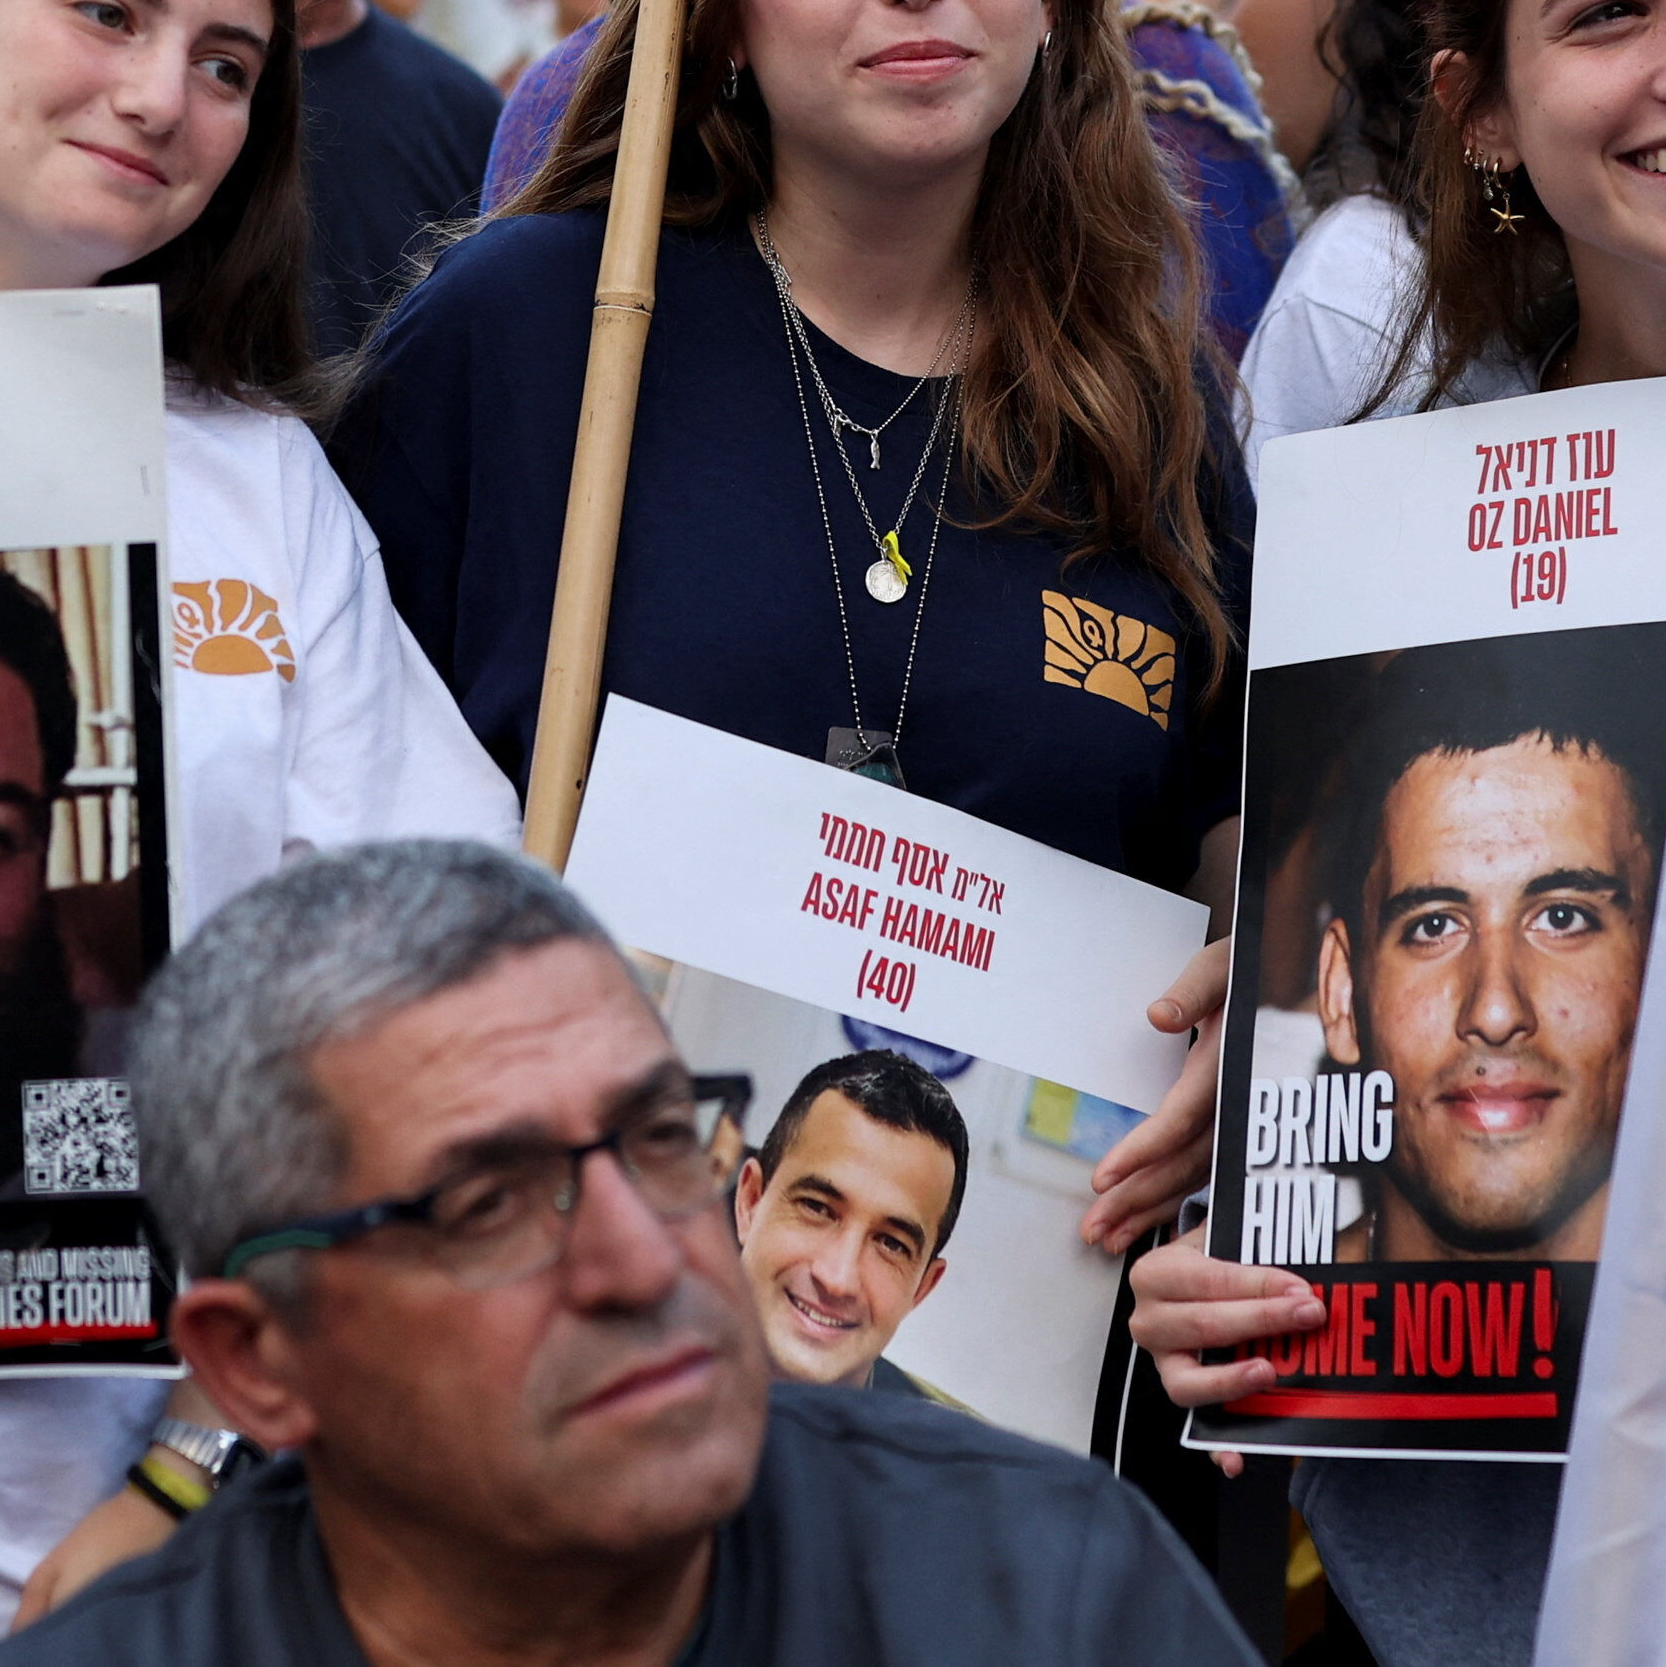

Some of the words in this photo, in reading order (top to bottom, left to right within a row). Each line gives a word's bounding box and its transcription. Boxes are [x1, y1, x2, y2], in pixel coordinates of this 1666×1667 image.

[1475, 436, 1558, 495] דניאל
[1566, 428, 1616, 483] עוז
[1467, 500, 1505, 552] OZ
[1513, 487, 1618, 547] DANIEL
[1510, 546, 1567, 610] (19)
[819, 812, 887, 874] חממי
[891, 836, 950, 895] אסף
[800, 871, 879, 931] ASAF
[879, 895, 996, 973] HAMAMI
[856, 949, 916, 1014] (40)
[1247, 1070, 1394, 1166] BRING
[1240, 1174, 1335, 1266] HIM
[17, 1246, 59, 1283] AND
[60, 1245, 151, 1282] MISSING
[48, 1280, 152, 1329] FORUM
[1238, 1282, 1378, 1378] ME
[1392, 1268, 1557, 1380] NOW!
